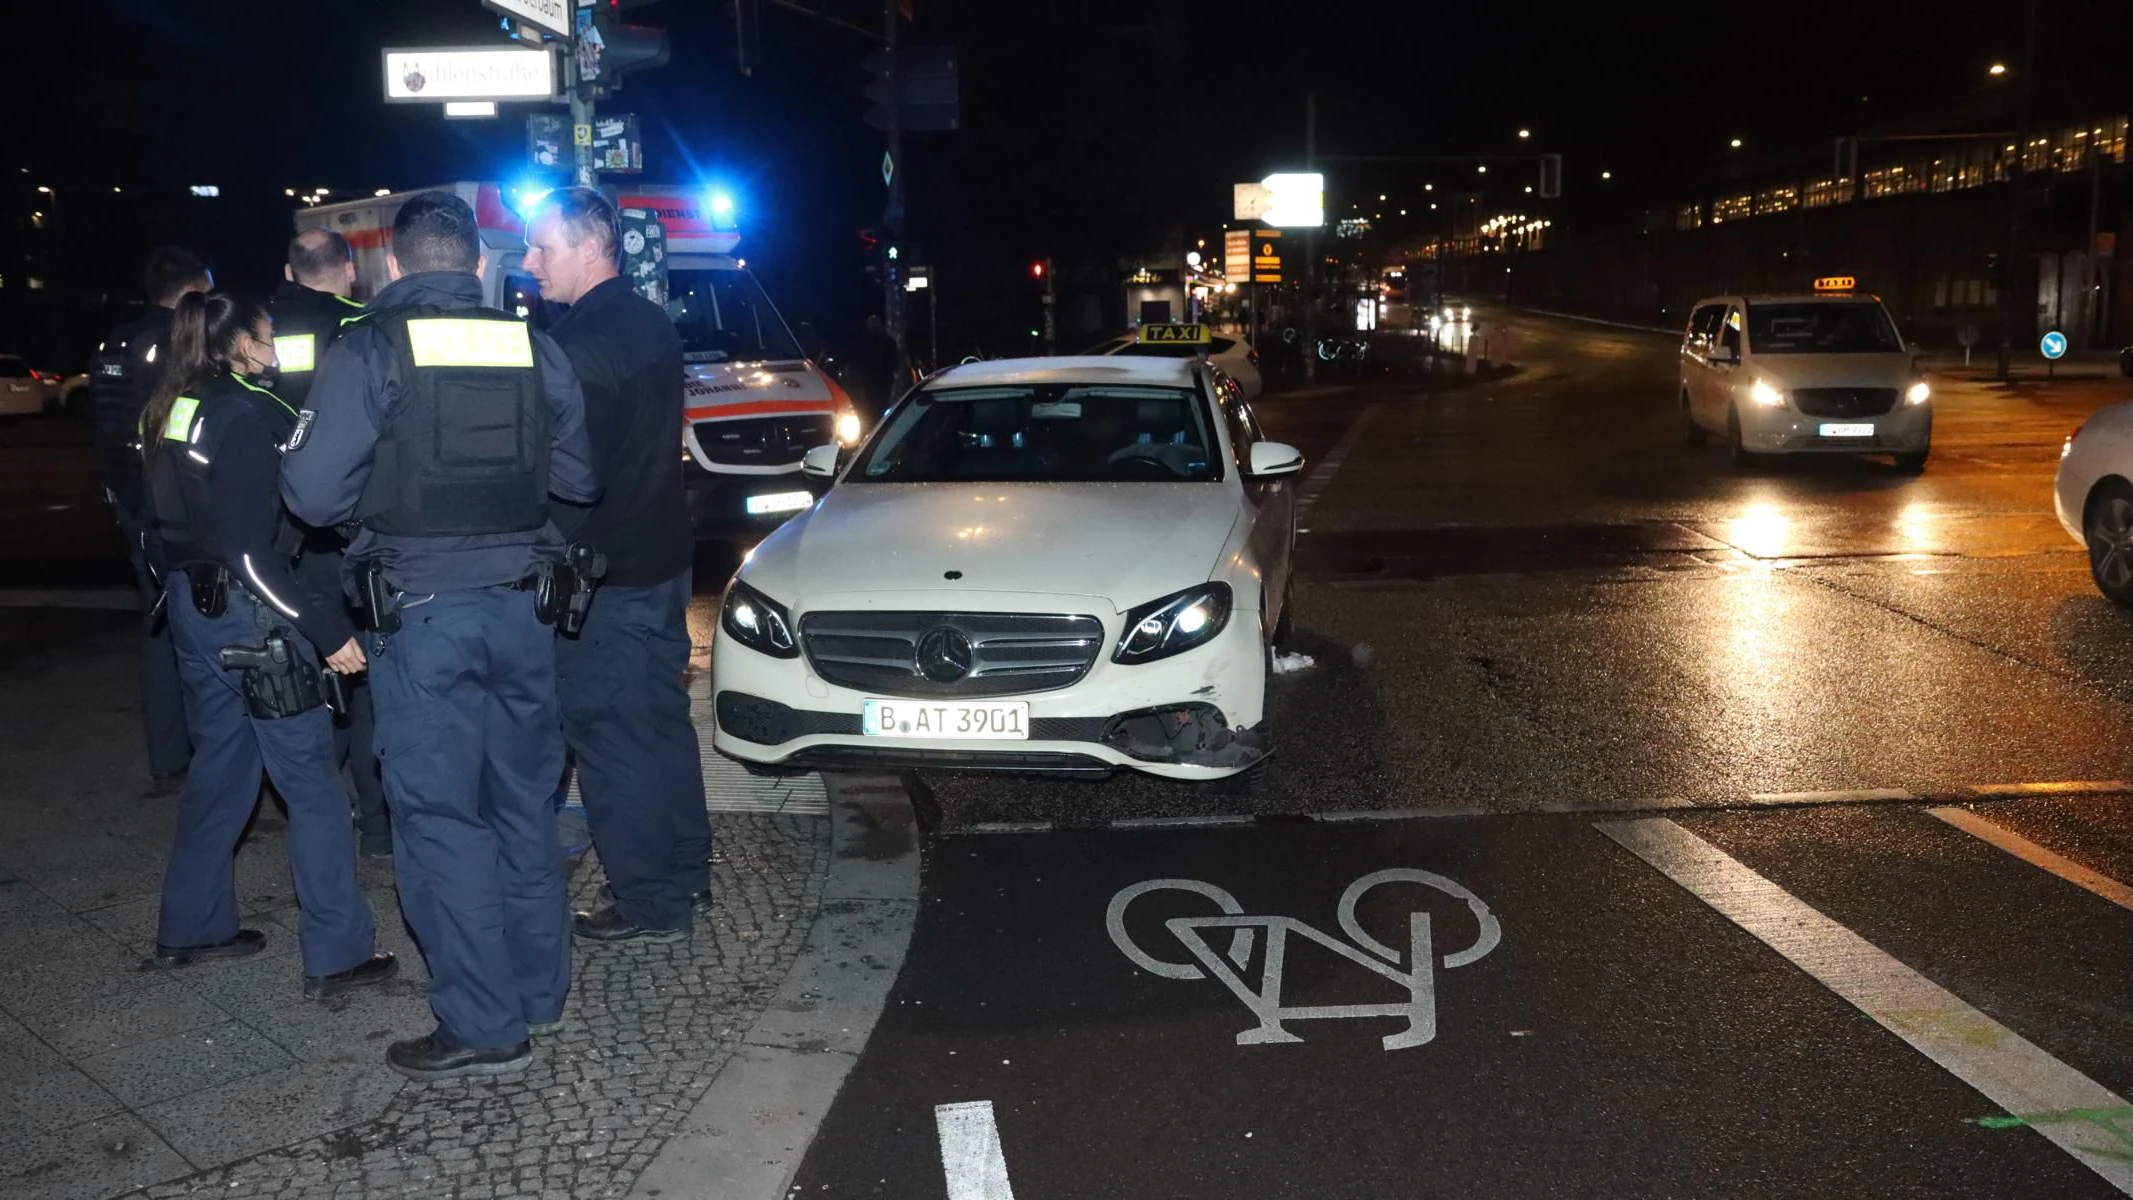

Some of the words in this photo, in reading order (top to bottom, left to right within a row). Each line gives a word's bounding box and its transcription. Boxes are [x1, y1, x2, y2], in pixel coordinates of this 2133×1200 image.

[1150, 326, 1198, 340] TAXI
[881, 706, 896, 731] B
[916, 708, 948, 732] AT
[957, 708, 1022, 733] 3901
